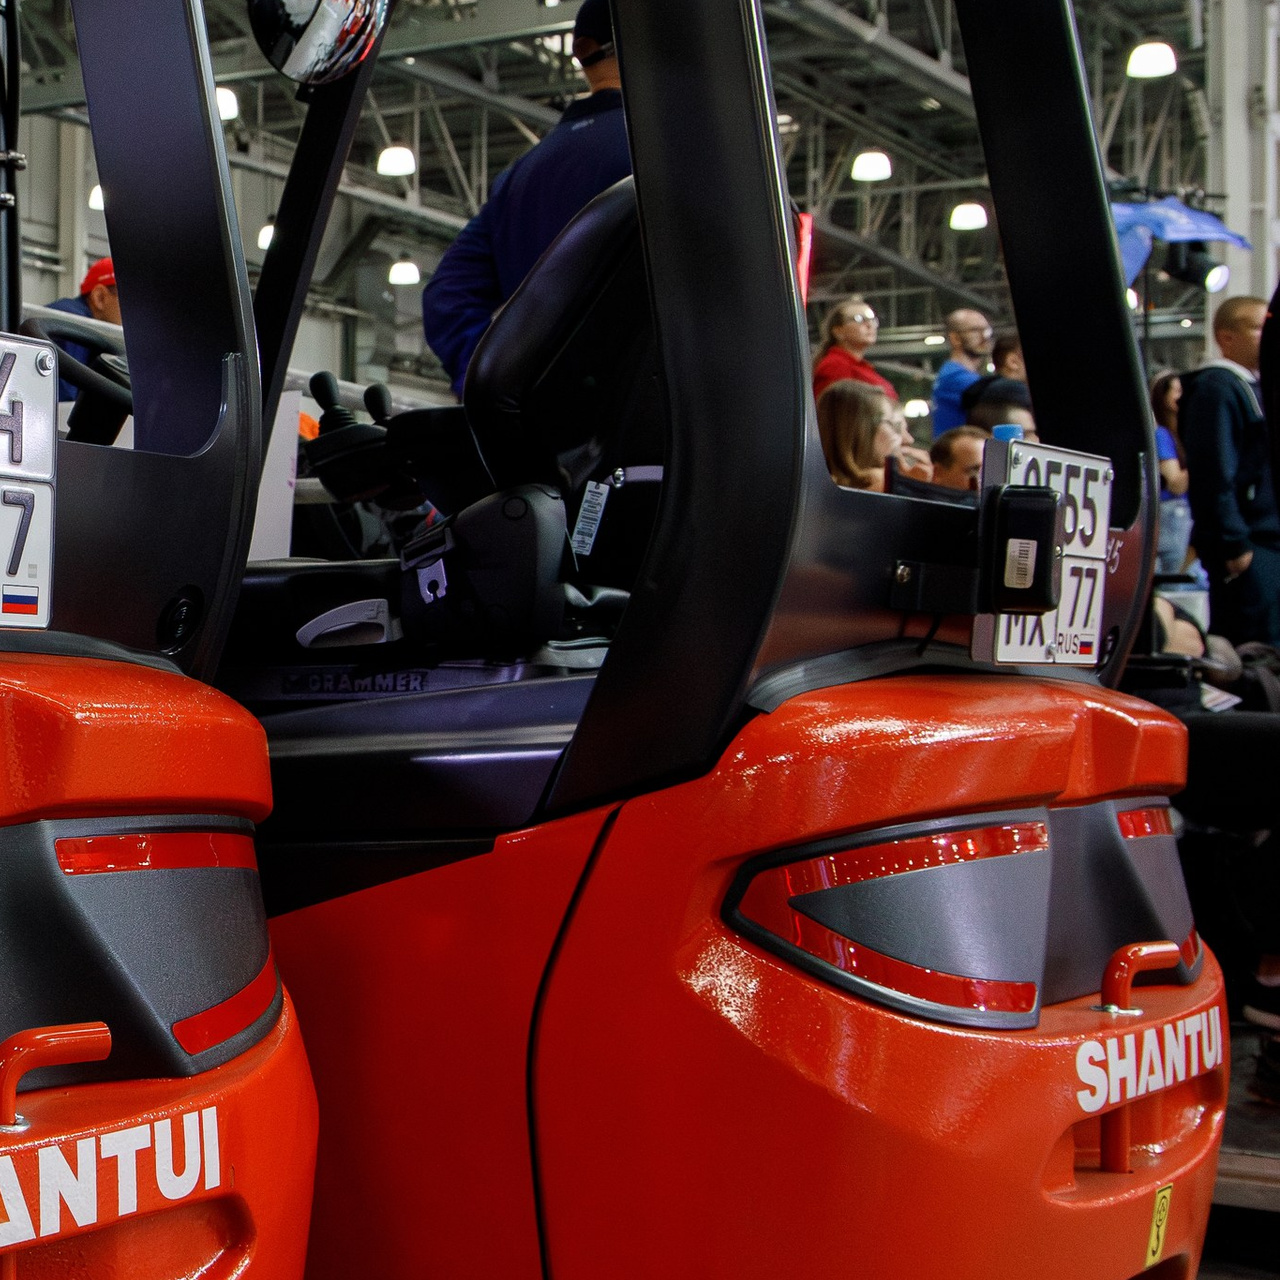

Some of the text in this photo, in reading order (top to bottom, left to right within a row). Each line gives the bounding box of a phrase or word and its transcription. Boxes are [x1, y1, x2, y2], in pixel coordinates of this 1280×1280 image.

[1068, 566, 1099, 628] 77
[1057, 632, 1080, 654] RUS
[1076, 1006, 1223, 1113] SHANTUI
